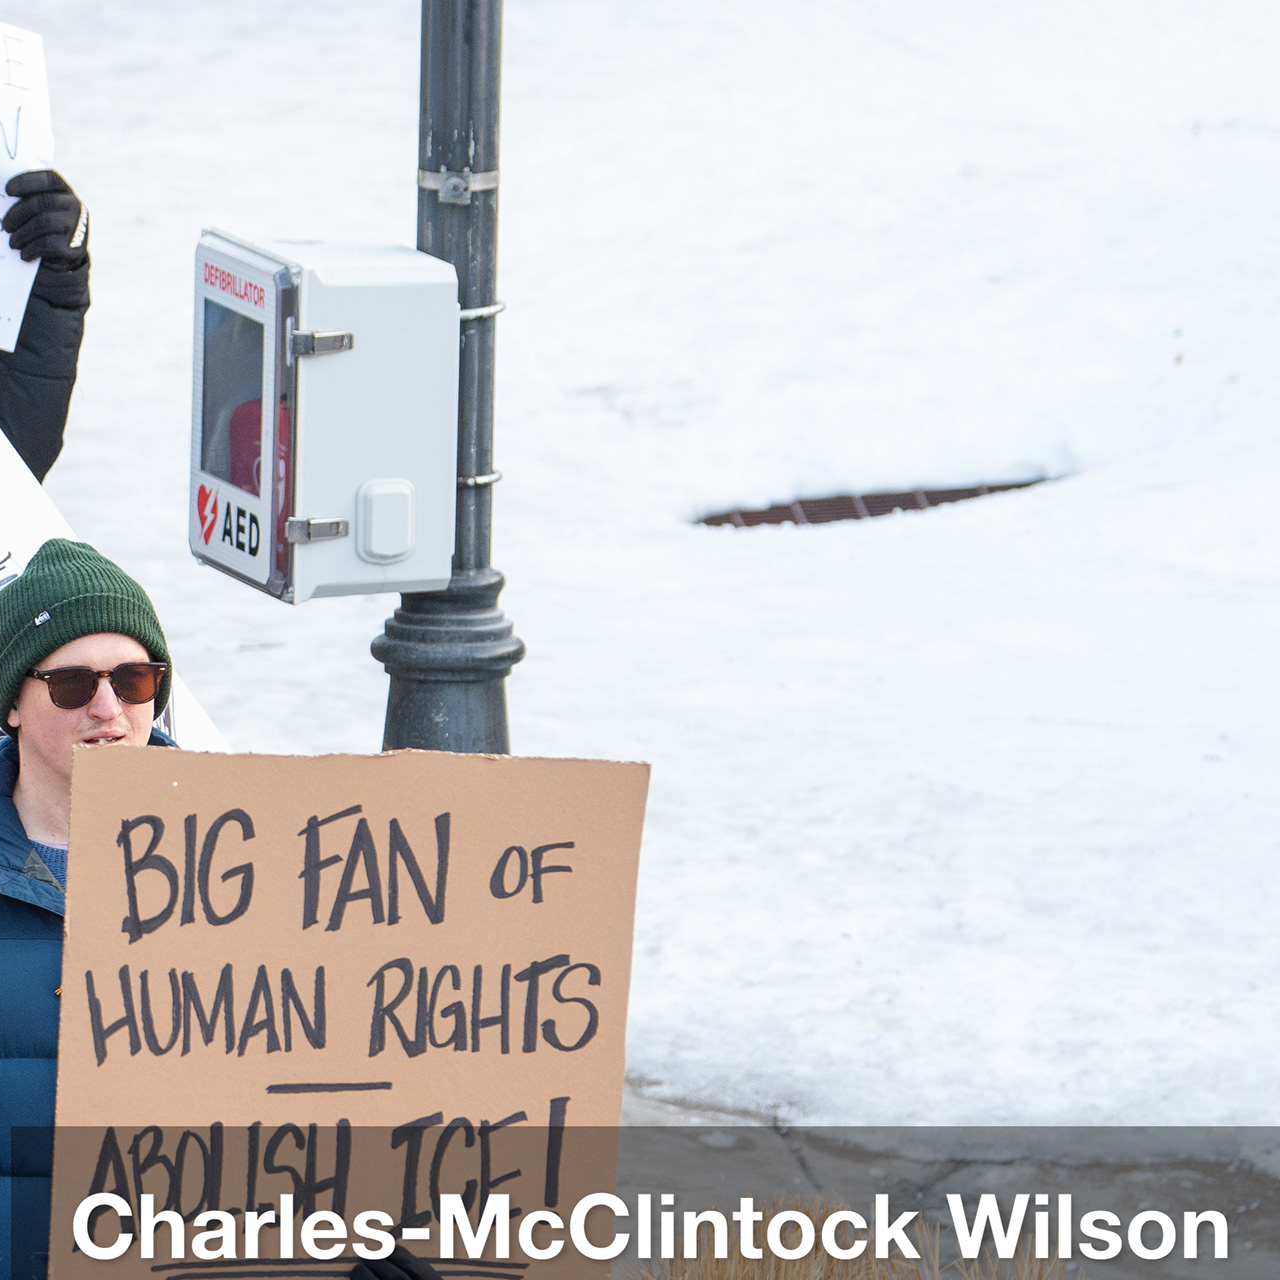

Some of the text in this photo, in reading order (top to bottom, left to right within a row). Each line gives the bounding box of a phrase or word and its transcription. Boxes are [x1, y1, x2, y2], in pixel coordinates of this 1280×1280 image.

[203, 262, 266, 309] DEFIBRILLATOR
[221, 501, 261, 556] AED
[116, 804, 575, 945] BIG FAN OF
[84, 953, 602, 1068] HUMAN RIGHTS
[72, 1096, 572, 1253] ABOLISH ICE!
